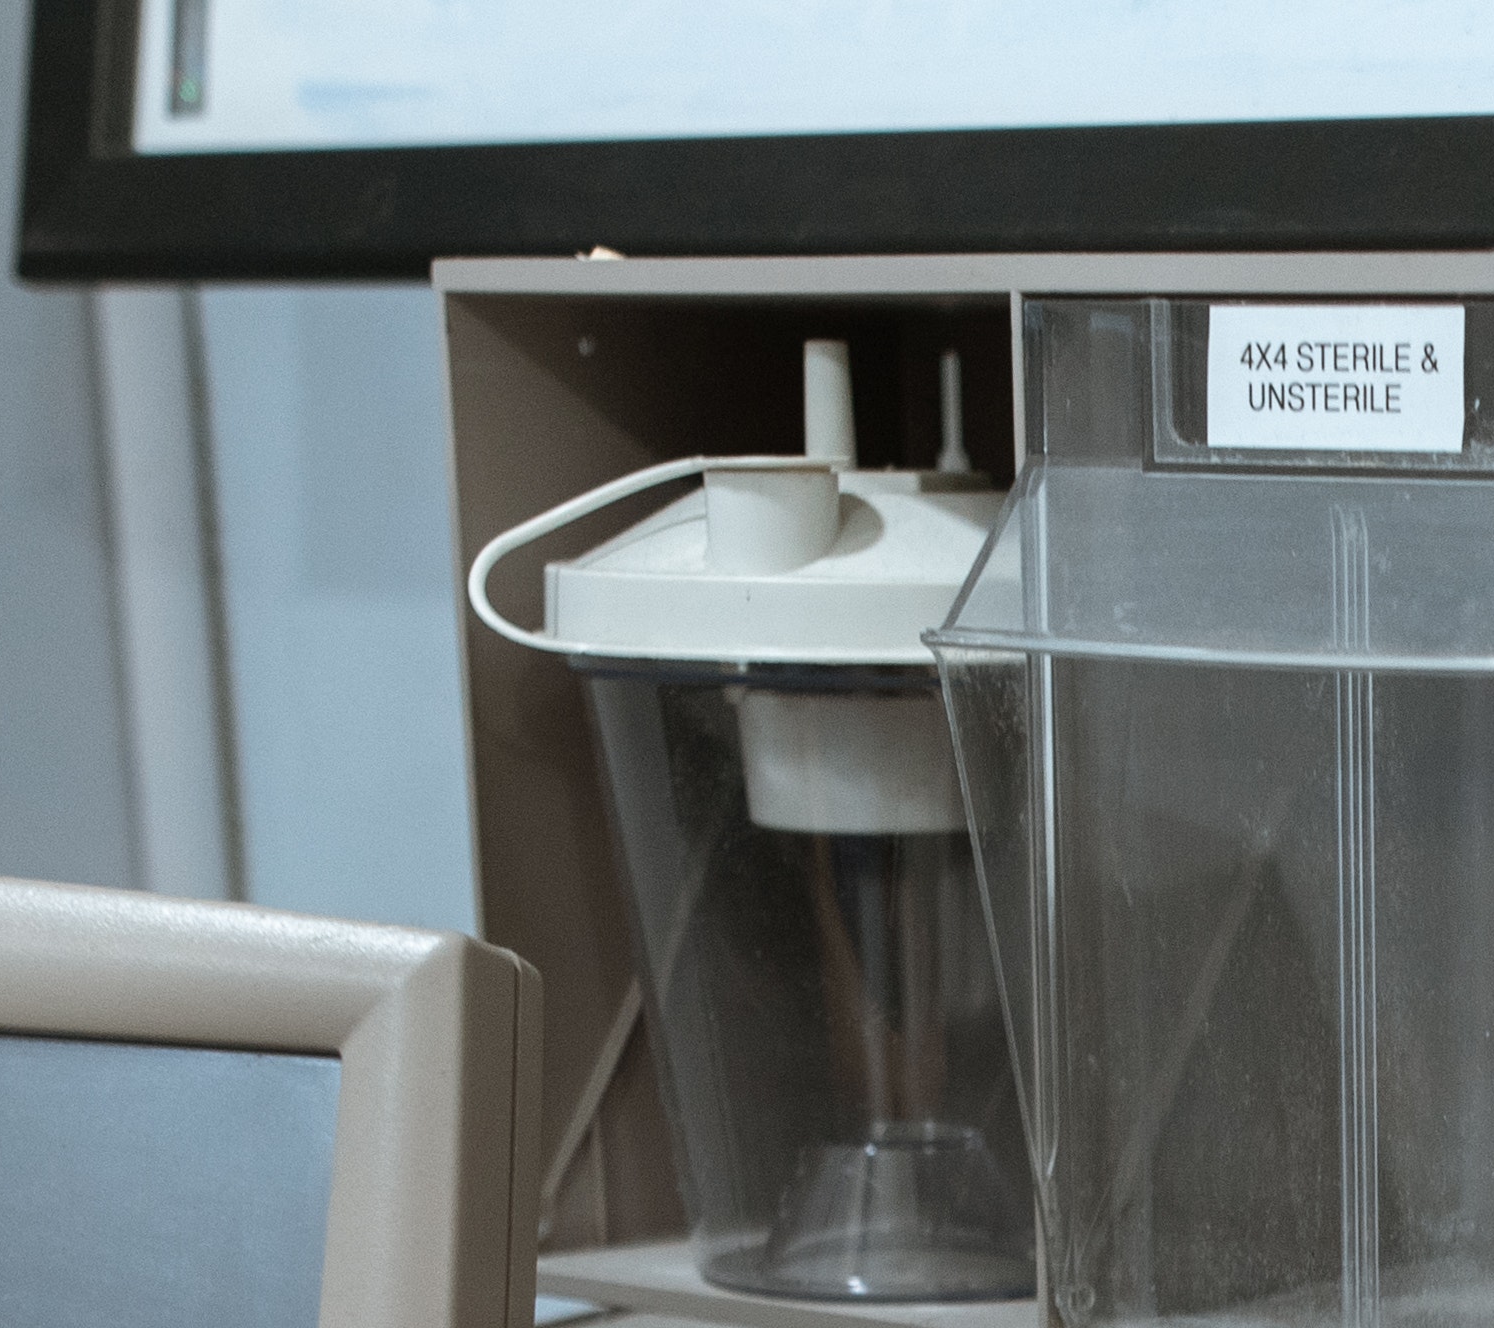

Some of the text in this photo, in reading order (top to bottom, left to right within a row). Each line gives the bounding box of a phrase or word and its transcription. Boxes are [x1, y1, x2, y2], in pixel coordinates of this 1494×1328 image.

[1240, 342, 1439, 373] 4X4 STERILE &
[1248, 383, 1402, 413] UNSTERILE
